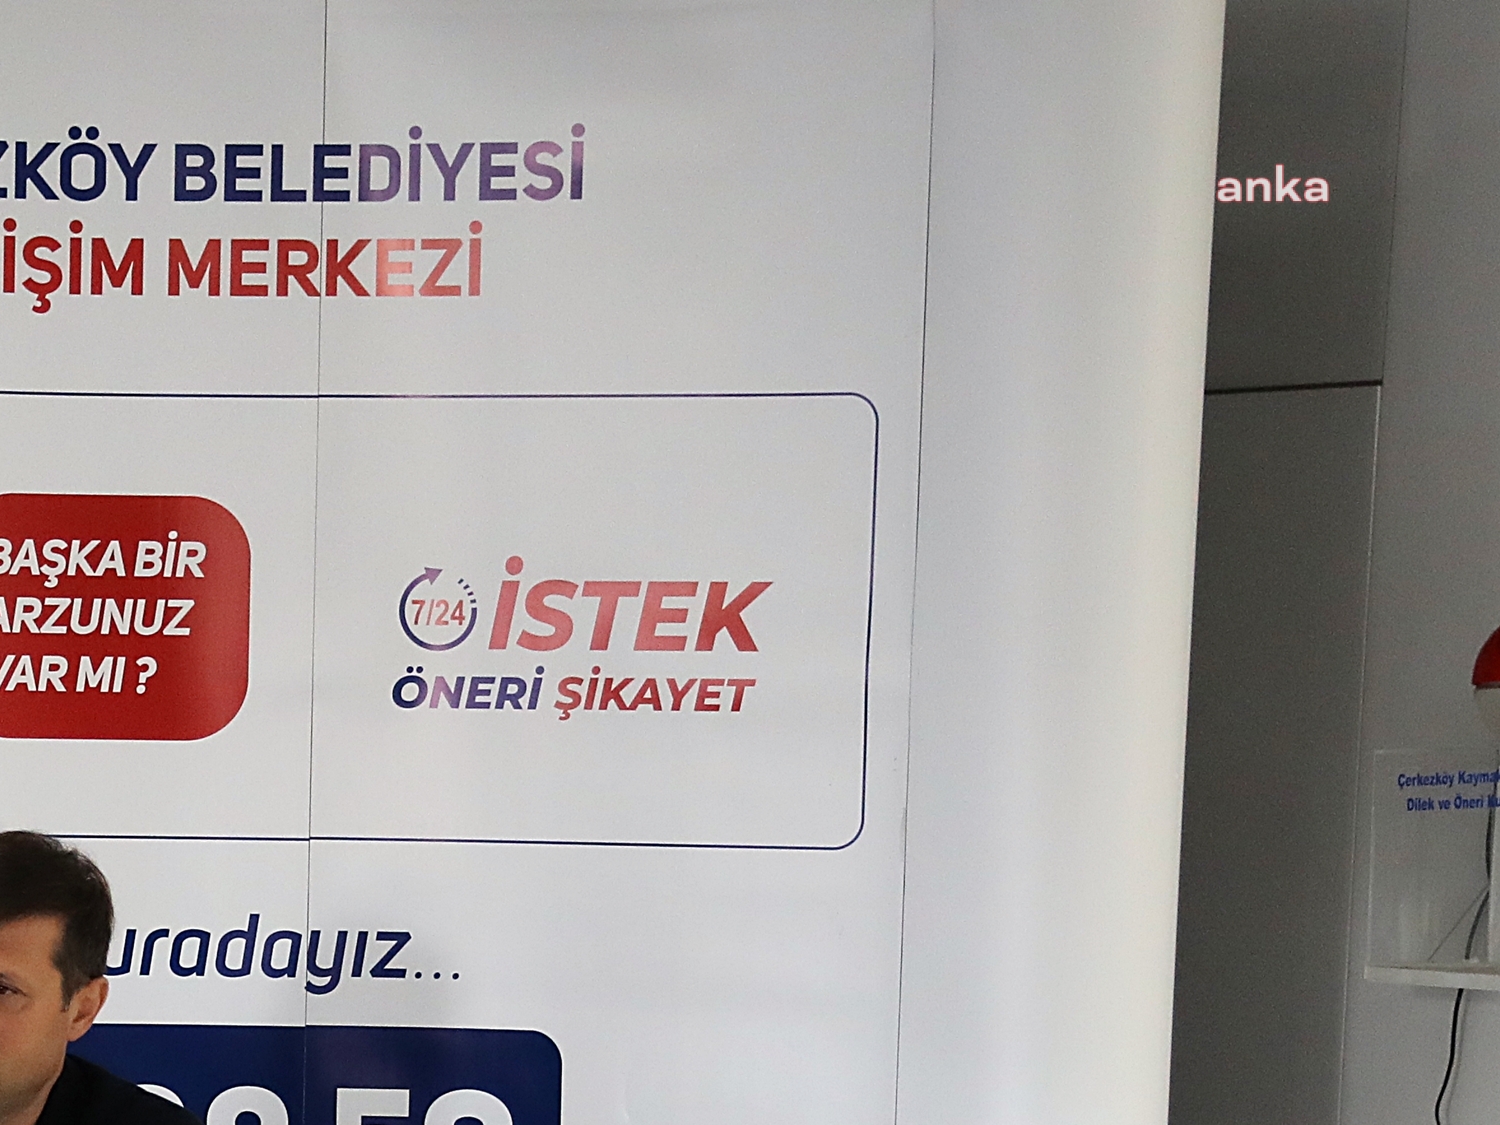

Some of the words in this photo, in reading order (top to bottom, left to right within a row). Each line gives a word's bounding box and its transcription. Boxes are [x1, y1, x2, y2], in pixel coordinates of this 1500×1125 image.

[175, 122, 587, 203] BELEDİYESİ
[167, 219, 485, 299] MERKEZİ
[133, 530, 208, 579] BİR
[411, 597, 466, 627] 7/24
[487, 555, 774, 652] İSTEK
[75, 656, 126, 693] MI
[136, 656, 158, 695] ?
[391, 665, 546, 710] ÖNERİ
[553, 665, 757, 721] ŞİKAYET
[1397, 770, 1455, 790] Çerkezköy
[1406, 797, 1435, 812] Dilek
[1437, 799, 1451, 810] ve
[1453, 792, 1484, 810] Öneri
